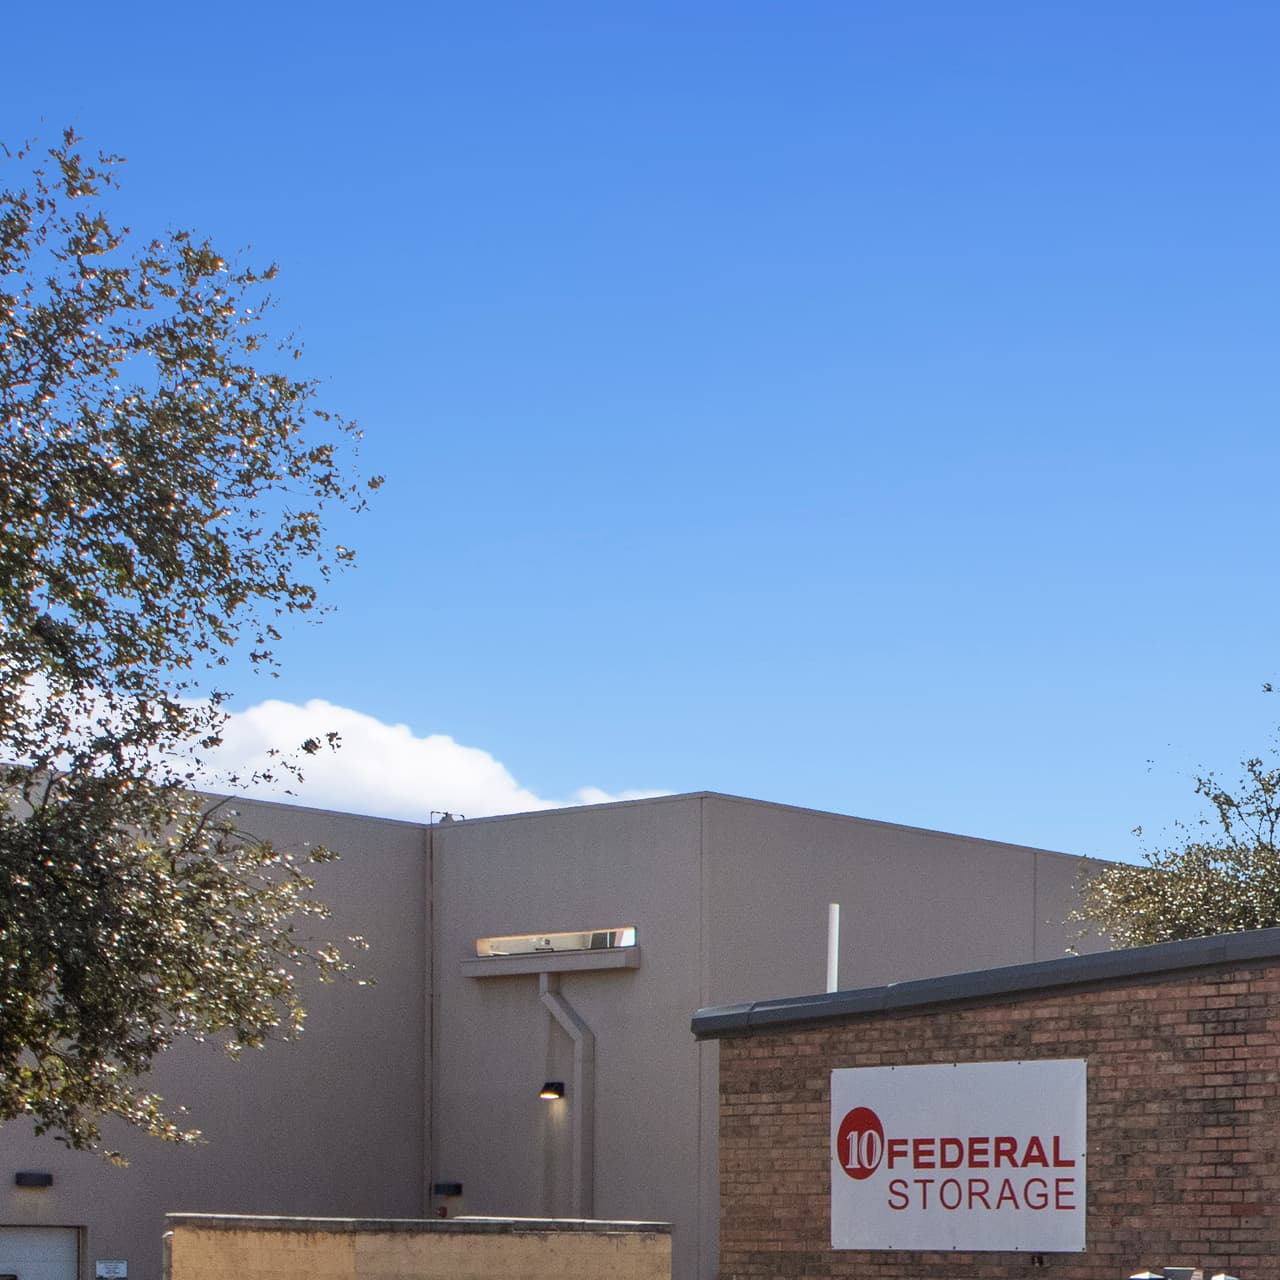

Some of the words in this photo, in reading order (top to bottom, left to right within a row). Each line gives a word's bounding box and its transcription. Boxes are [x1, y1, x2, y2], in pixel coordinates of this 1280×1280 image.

[845, 1130, 881, 1170] 10
[887, 1136, 1076, 1169] FEDERAL
[888, 1178, 1076, 1210] STORAGE
